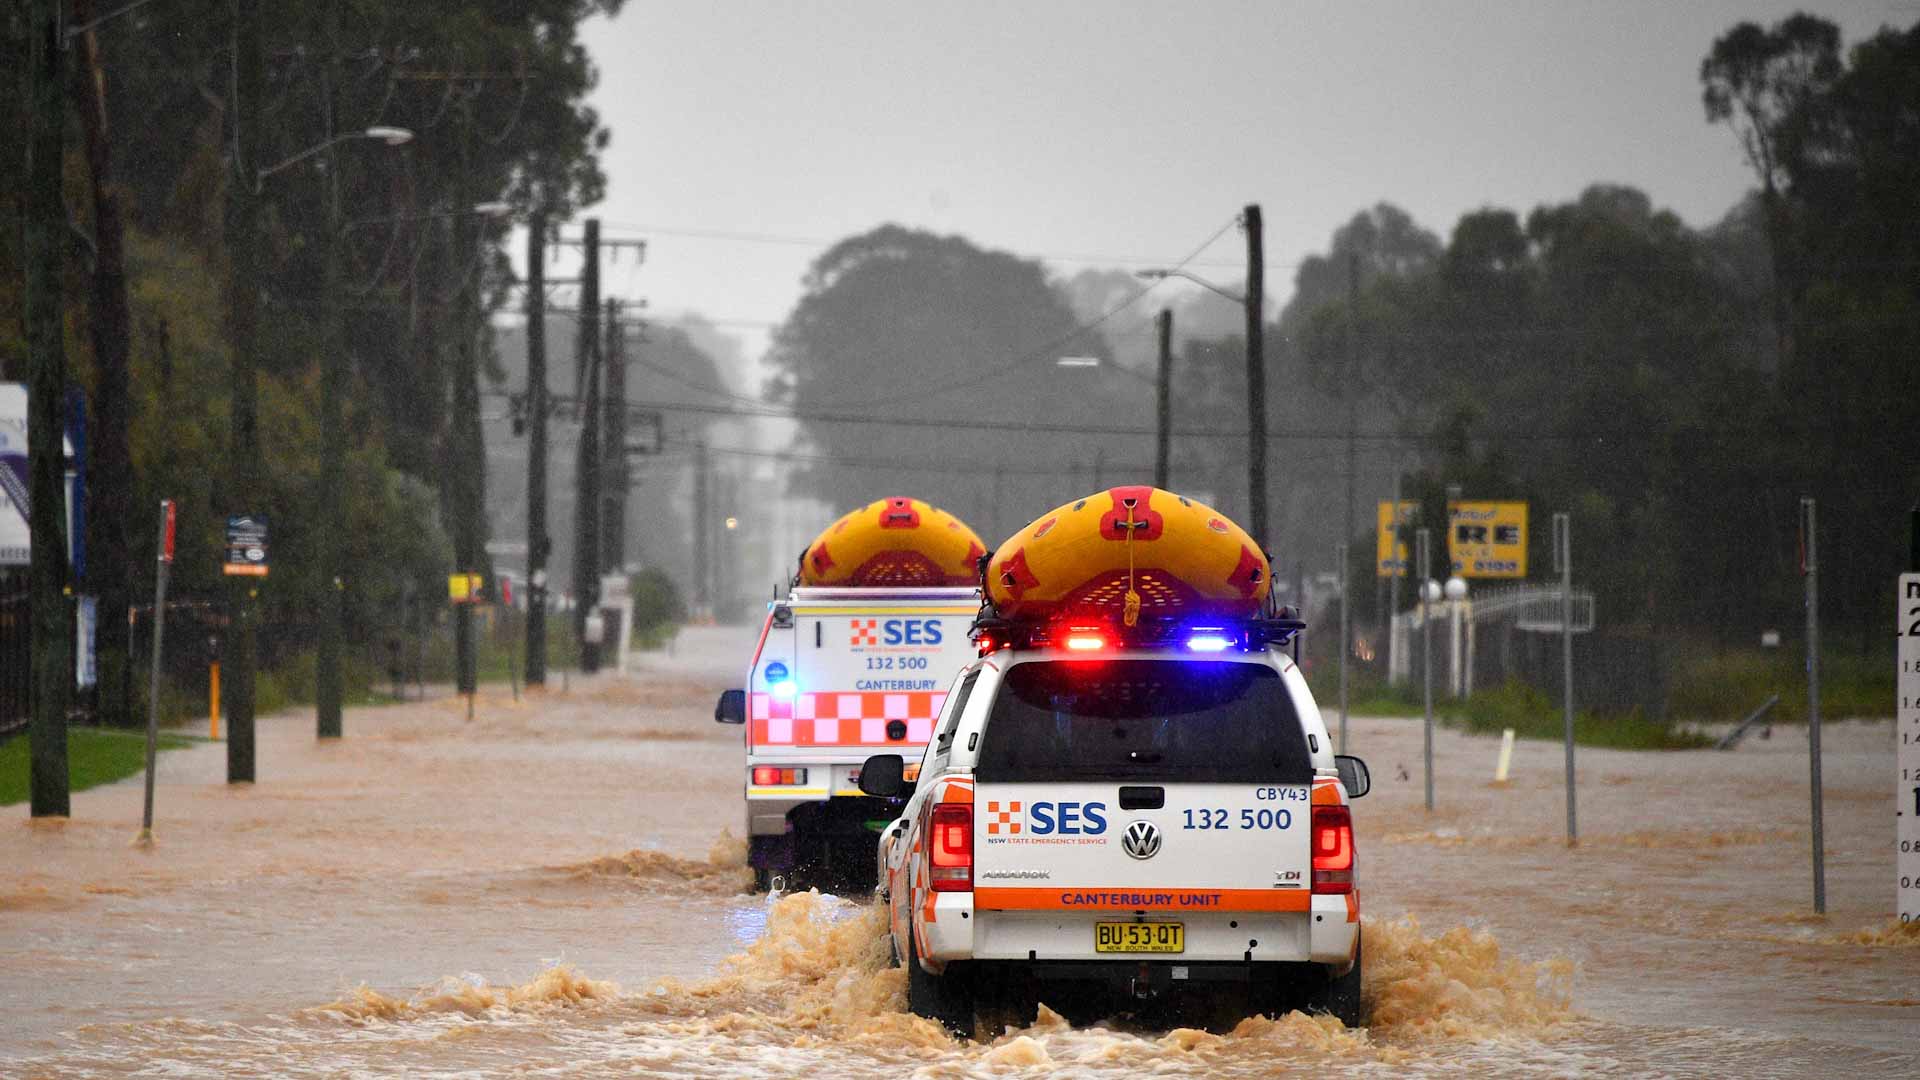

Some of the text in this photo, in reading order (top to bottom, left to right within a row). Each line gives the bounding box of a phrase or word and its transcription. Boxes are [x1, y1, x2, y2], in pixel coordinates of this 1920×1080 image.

[884, 619, 943, 645] SES
[866, 657, 927, 670] 132 500
[856, 680, 936, 690] CANTERBURY
[1256, 788, 1308, 801] CBY43
[1030, 801, 1107, 835] SES
[1183, 808, 1292, 830] 132 500
[1274, 871, 1301, 880] TDI
[1061, 893, 1222, 906] CANTERBURY UNIT
